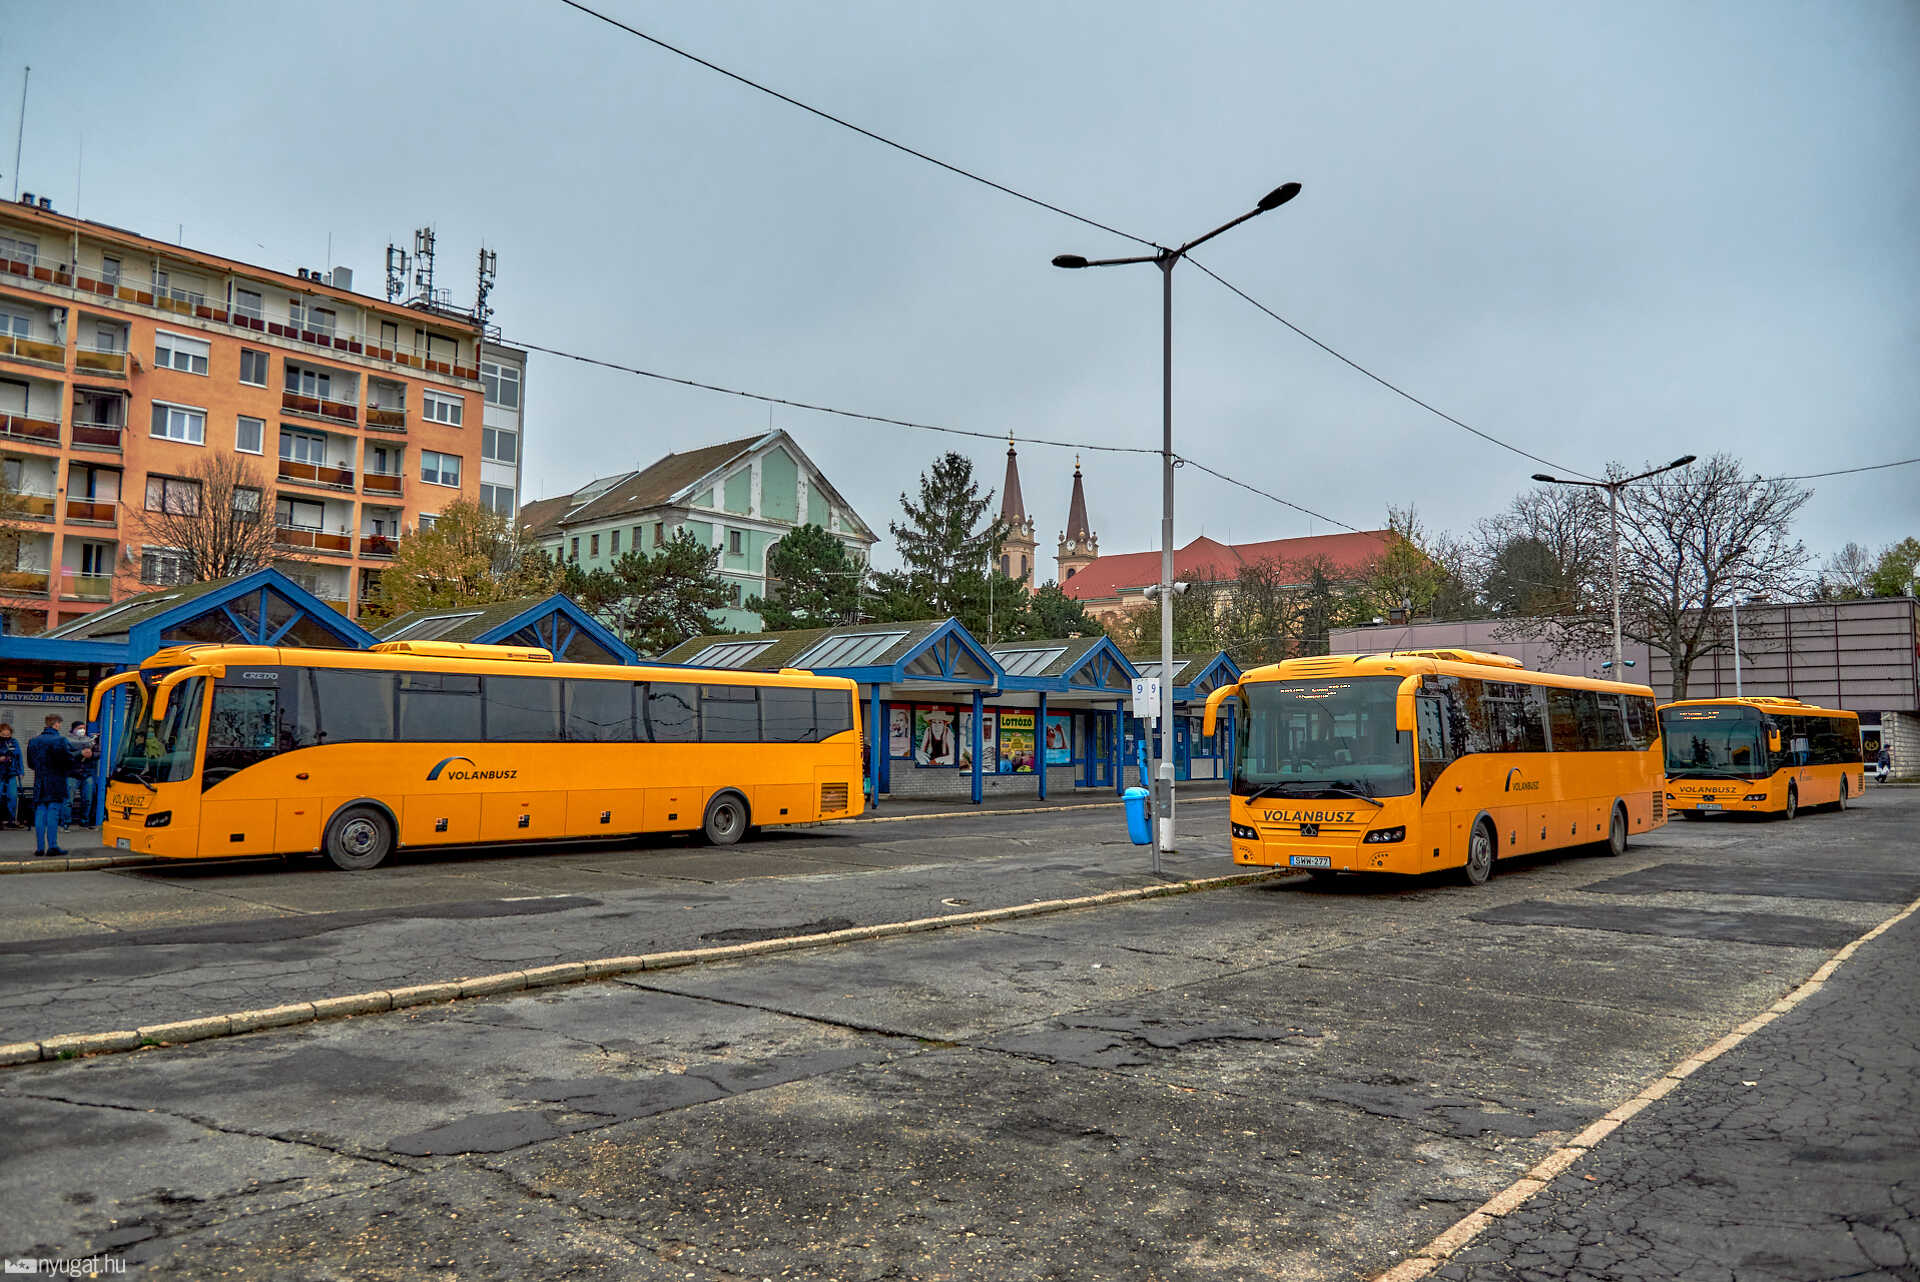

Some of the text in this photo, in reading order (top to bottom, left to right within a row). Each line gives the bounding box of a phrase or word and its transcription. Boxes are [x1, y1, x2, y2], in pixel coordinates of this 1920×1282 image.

[242, 671, 279, 680] CREDO
[1136, 684, 1143, 694] 9
[1151, 683, 1157, 694] 9
[1295, 856, 1328, 865] SWW-277
